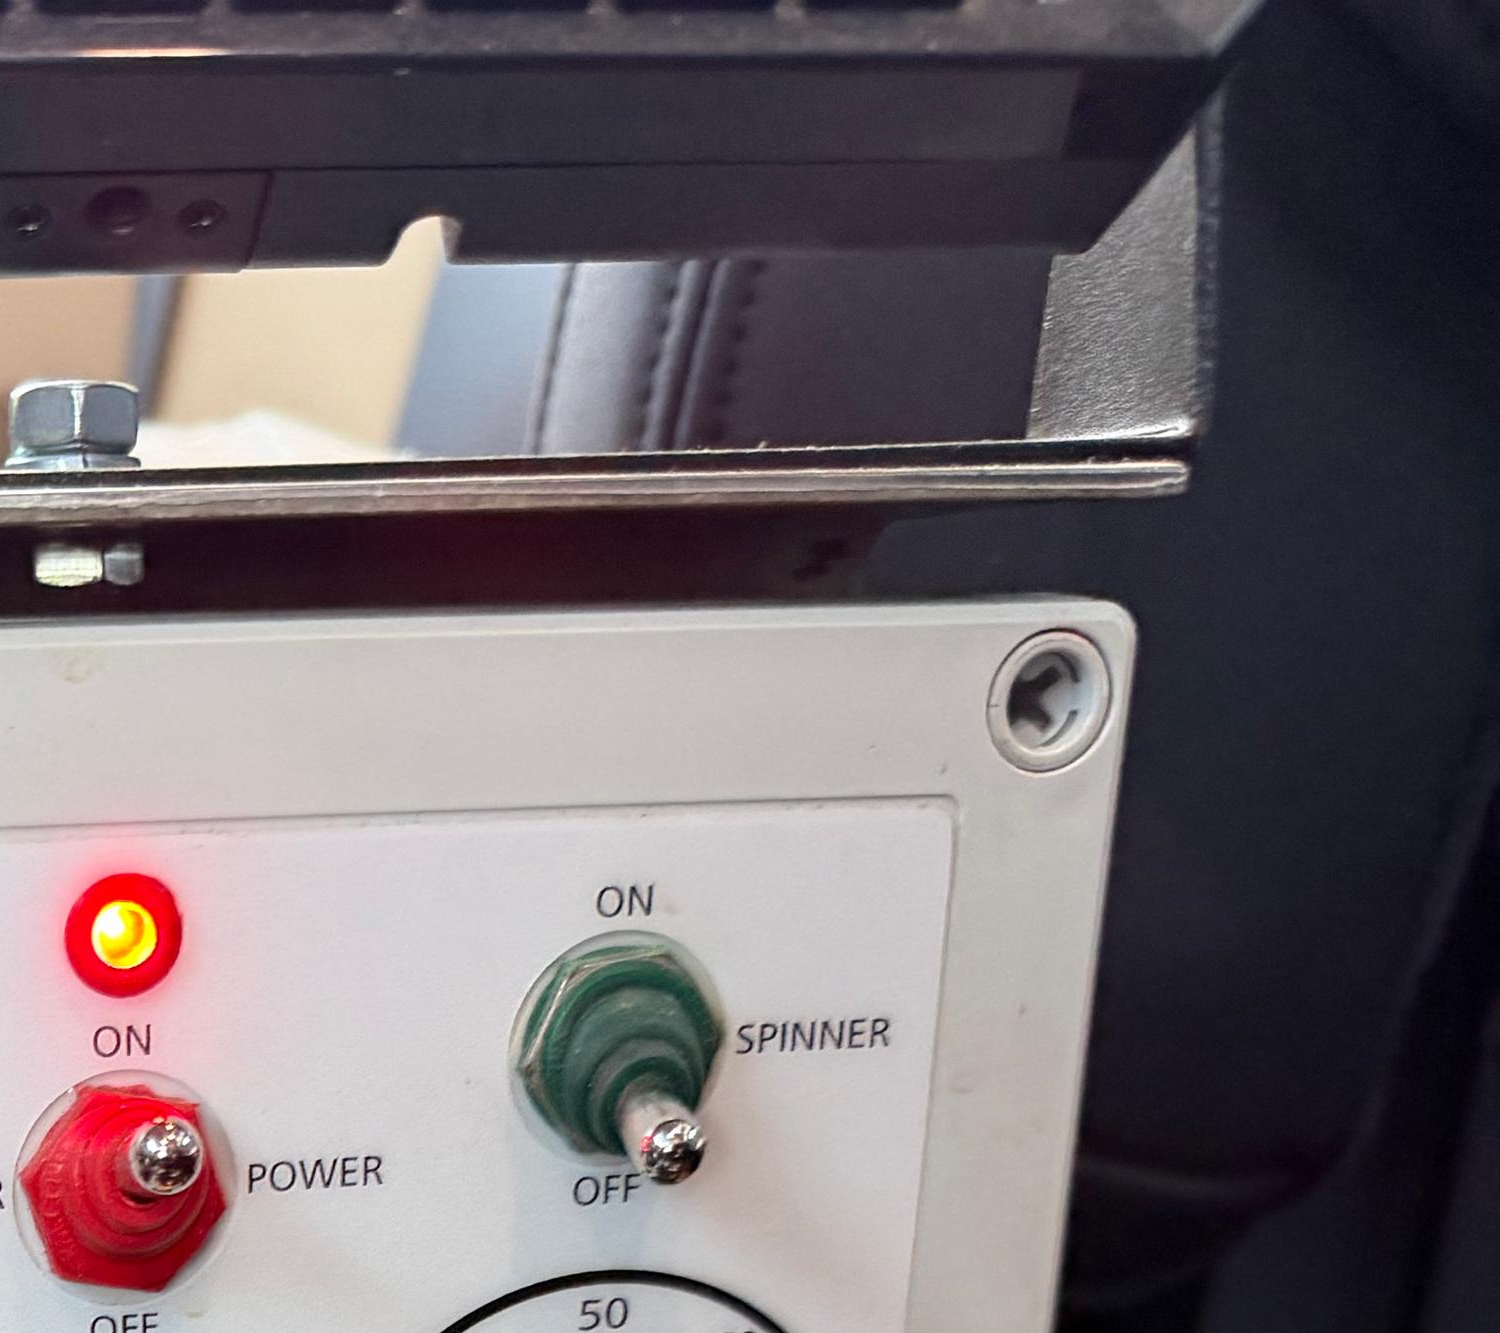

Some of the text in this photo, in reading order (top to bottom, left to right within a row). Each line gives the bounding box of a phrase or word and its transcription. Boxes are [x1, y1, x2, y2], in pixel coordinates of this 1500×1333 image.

[596, 884, 655, 918] ON
[92, 1024, 152, 1058] ON
[736, 1017, 892, 1055] SPINNER
[247, 1155, 384, 1193] POWER
[572, 1173, 642, 1207] OFF
[578, 1297, 629, 1332] 50
